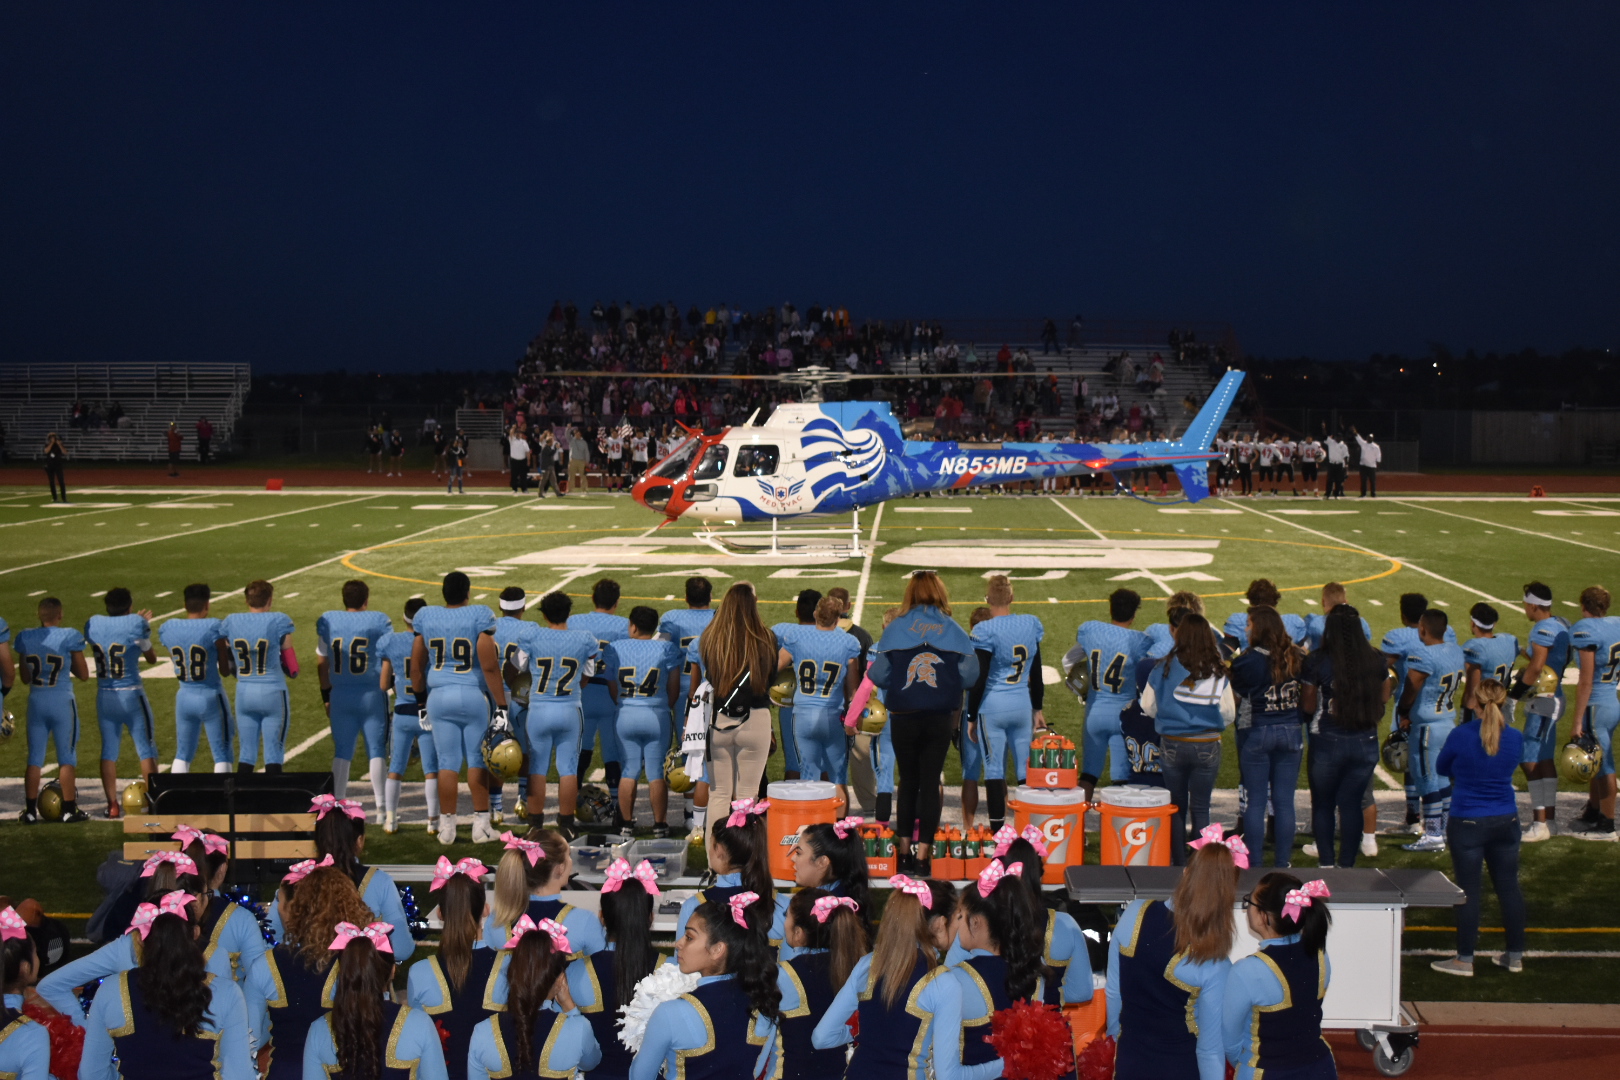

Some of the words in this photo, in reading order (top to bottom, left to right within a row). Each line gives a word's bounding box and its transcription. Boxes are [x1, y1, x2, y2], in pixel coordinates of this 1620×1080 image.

[938, 456, 1028, 475] N853MB
[760, 495, 777, 508] MED
[908, 618, 944, 639] Lopez
[25, 653, 64, 687] 27
[170, 643, 207, 682] 38
[233, 637, 269, 676] 31
[331, 636, 370, 675] 16
[428, 636, 473, 674] 79
[1006, 644, 1029, 684] 3
[1088, 649, 1128, 694] 14
[535, 656, 579, 696] 72
[618, 666, 661, 698] 54
[797, 658, 842, 697] 87
[1045, 771, 1059, 786] G
[1043, 818, 1065, 842] G
[1124, 821, 1147, 846] G
[953, 845, 962, 856] G
